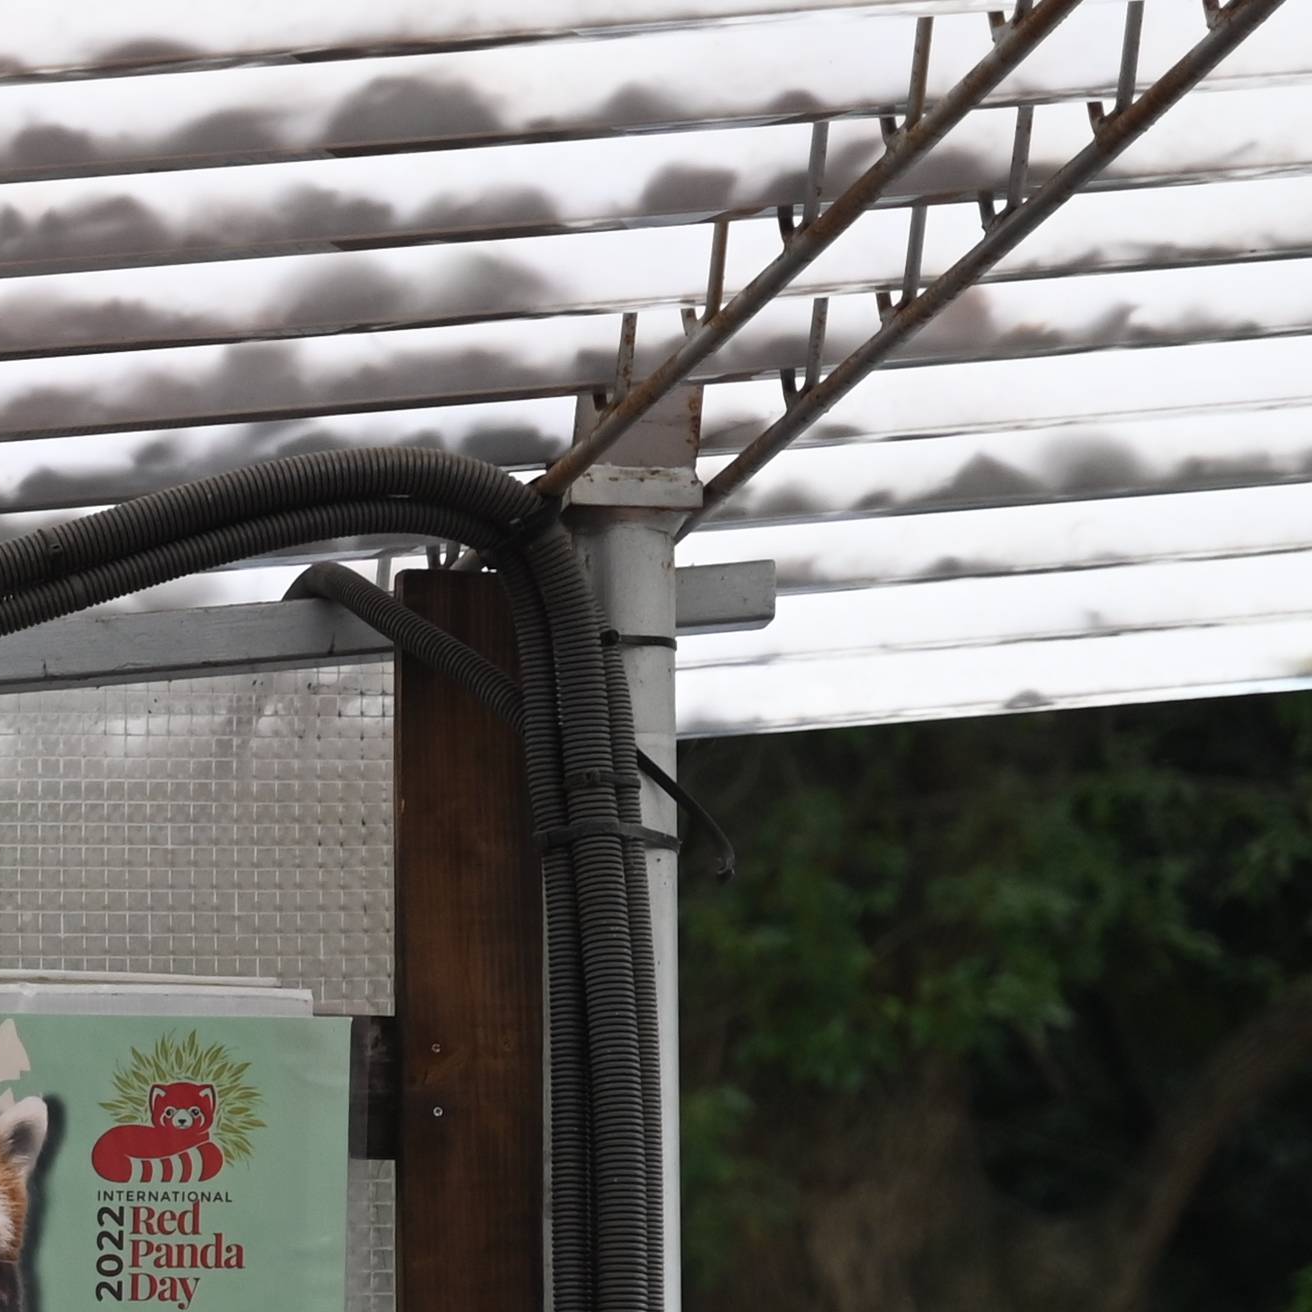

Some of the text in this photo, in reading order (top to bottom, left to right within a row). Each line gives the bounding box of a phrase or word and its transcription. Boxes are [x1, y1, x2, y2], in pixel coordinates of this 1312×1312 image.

[97, 1190, 233, 1203] INTERNATIONAL
[130, 1202, 201, 1236] Red
[95, 1206, 125, 1302] 2022
[129, 1234, 245, 1269] Panda
[128, 1272, 200, 1310] Day
